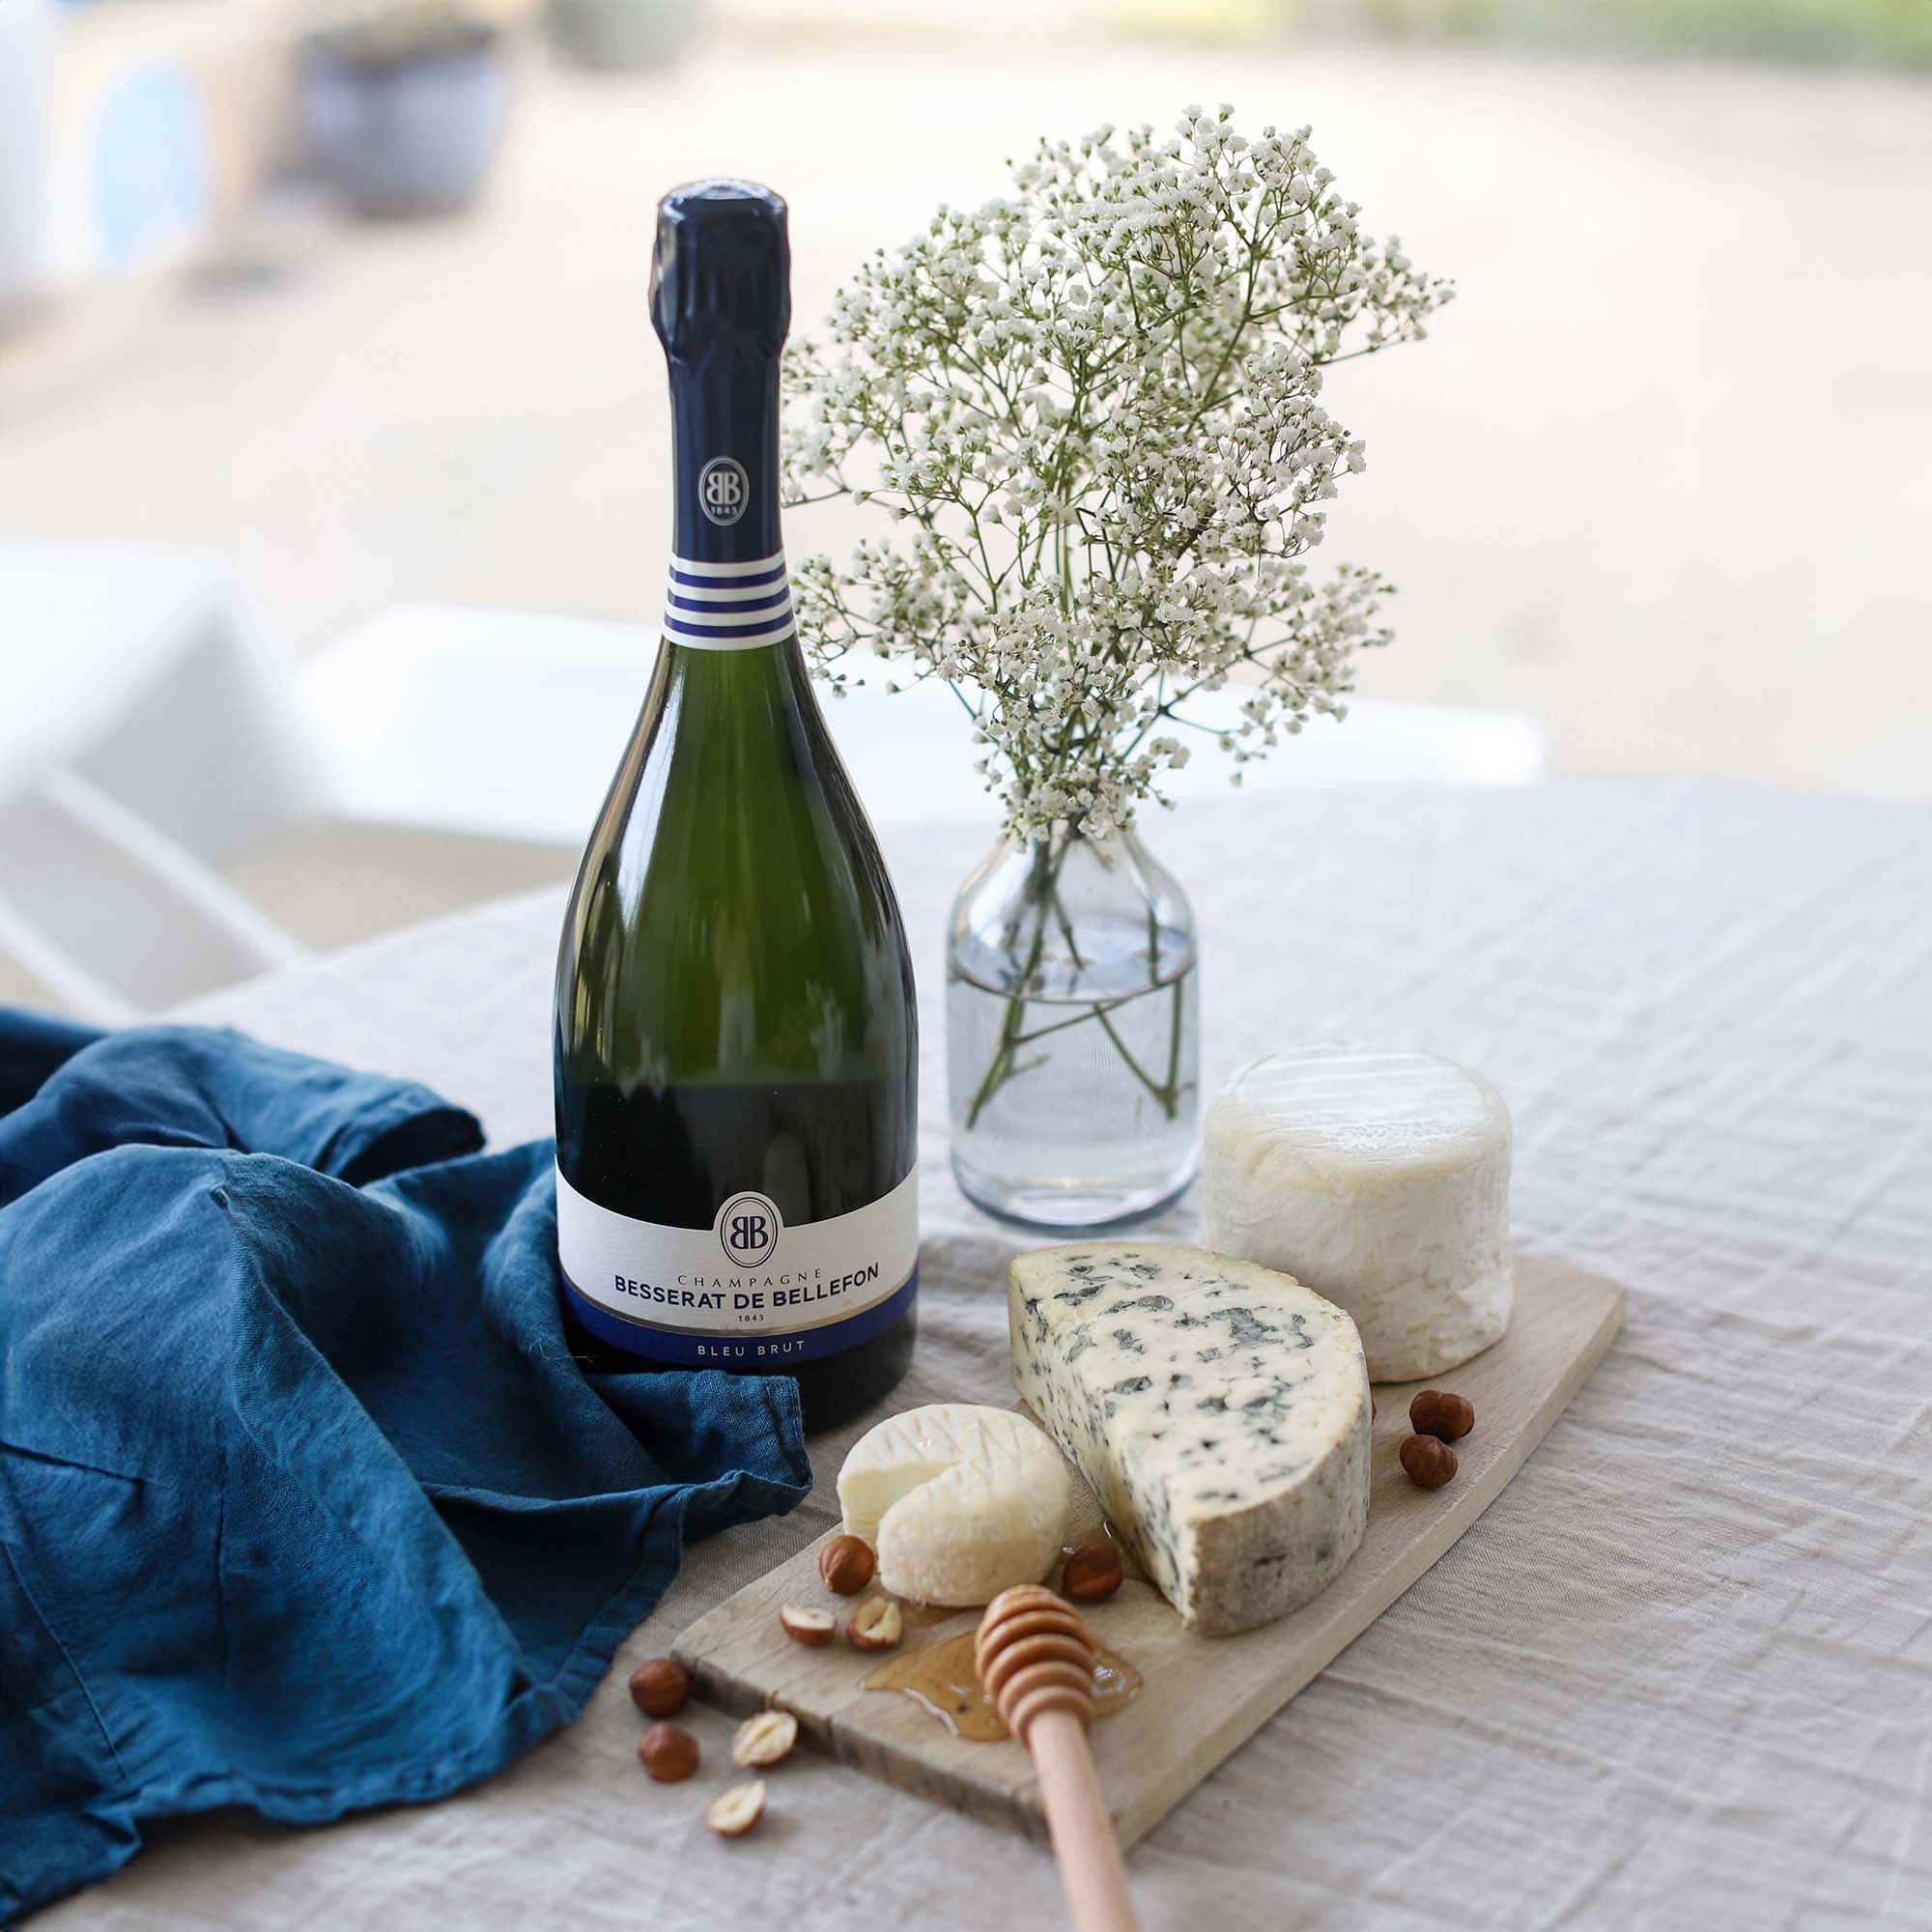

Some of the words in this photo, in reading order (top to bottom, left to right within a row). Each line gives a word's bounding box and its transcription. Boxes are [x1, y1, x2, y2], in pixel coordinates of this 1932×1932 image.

[614, 1274, 726, 1310] BESSERAT
[733, 1293, 765, 1310] DE
[773, 1262, 879, 1307] BELLEFON
[677, 1267, 823, 1288] CHAMPAGNE
[738, 1314, 765, 1323] 1843
[697, 1345, 745, 1356] BLEU
[757, 1340, 805, 1355] BRUT
